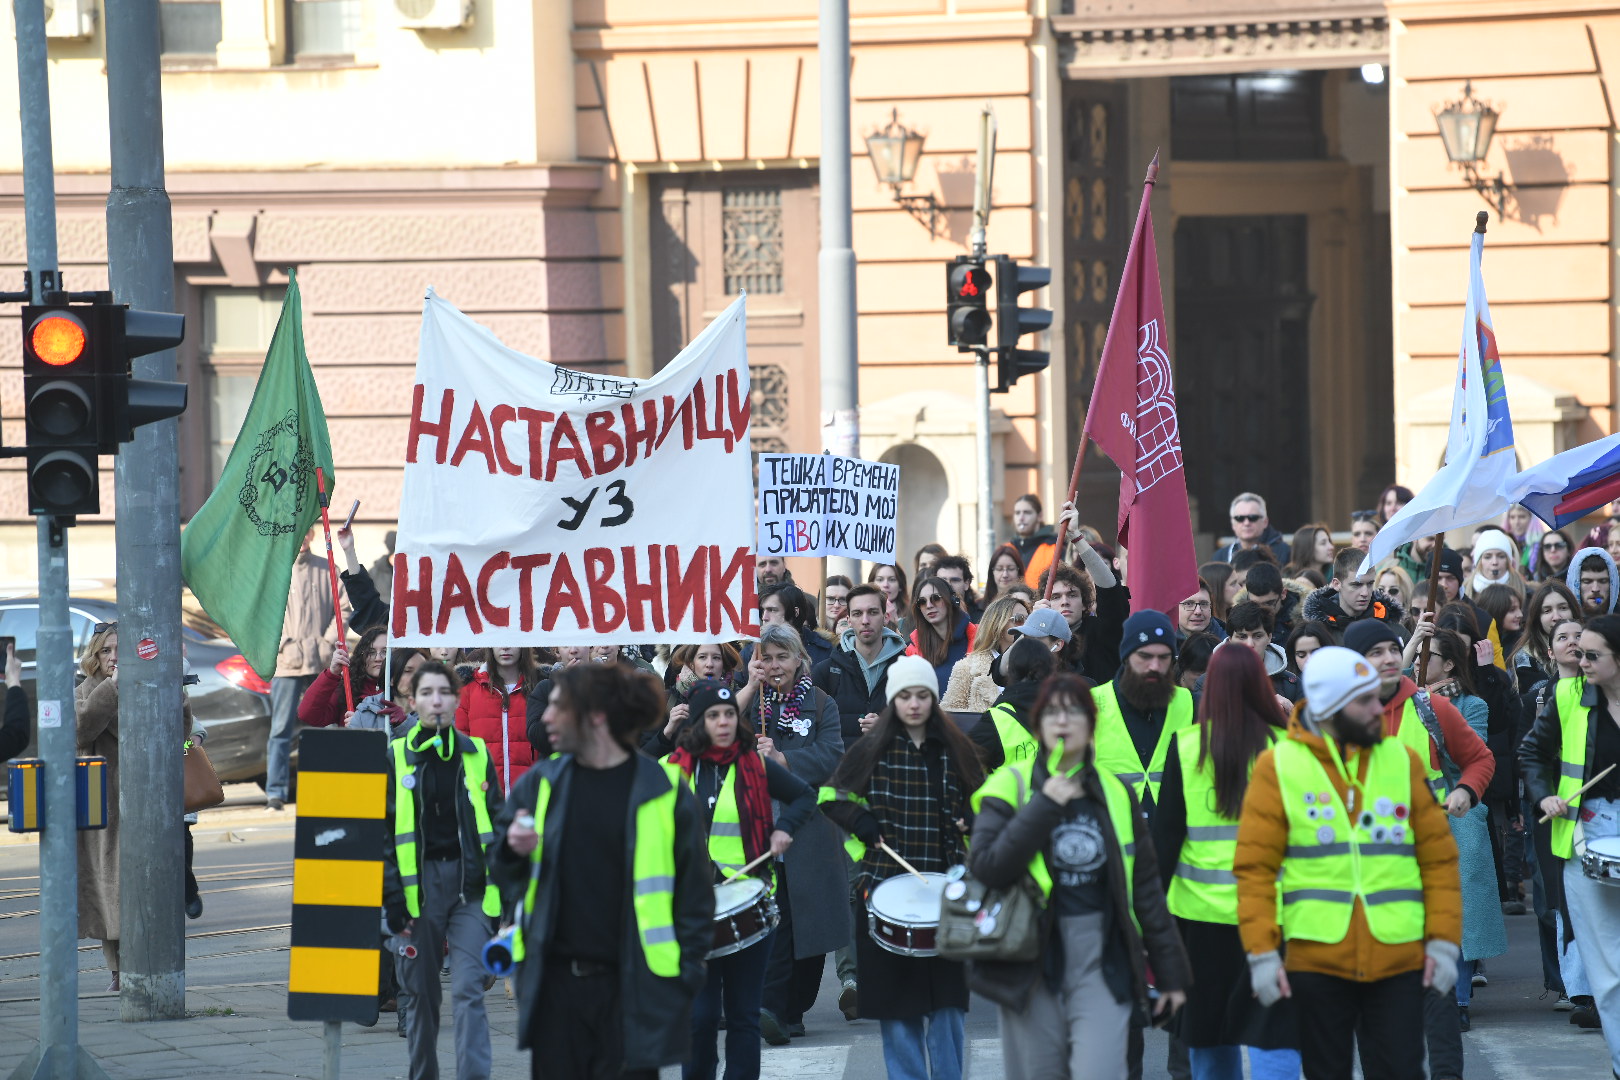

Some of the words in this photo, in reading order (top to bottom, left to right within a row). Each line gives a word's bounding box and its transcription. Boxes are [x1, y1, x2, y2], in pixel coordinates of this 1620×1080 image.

[764, 456, 826, 486] ТЕШКА
[832, 457, 897, 492] ВРЕМЕНА
[556, 479, 635, 531] УЗ
[763, 487, 859, 517] ПРИЈАТЕЉУ
[864, 493, 896, 520] МОЈ
[764, 519, 821, 554] ЂАВО
[825, 519, 851, 550] ИХ
[854, 521, 895, 555] ОДНИО
[391, 543, 761, 639] НАСТАВНИКЕ
